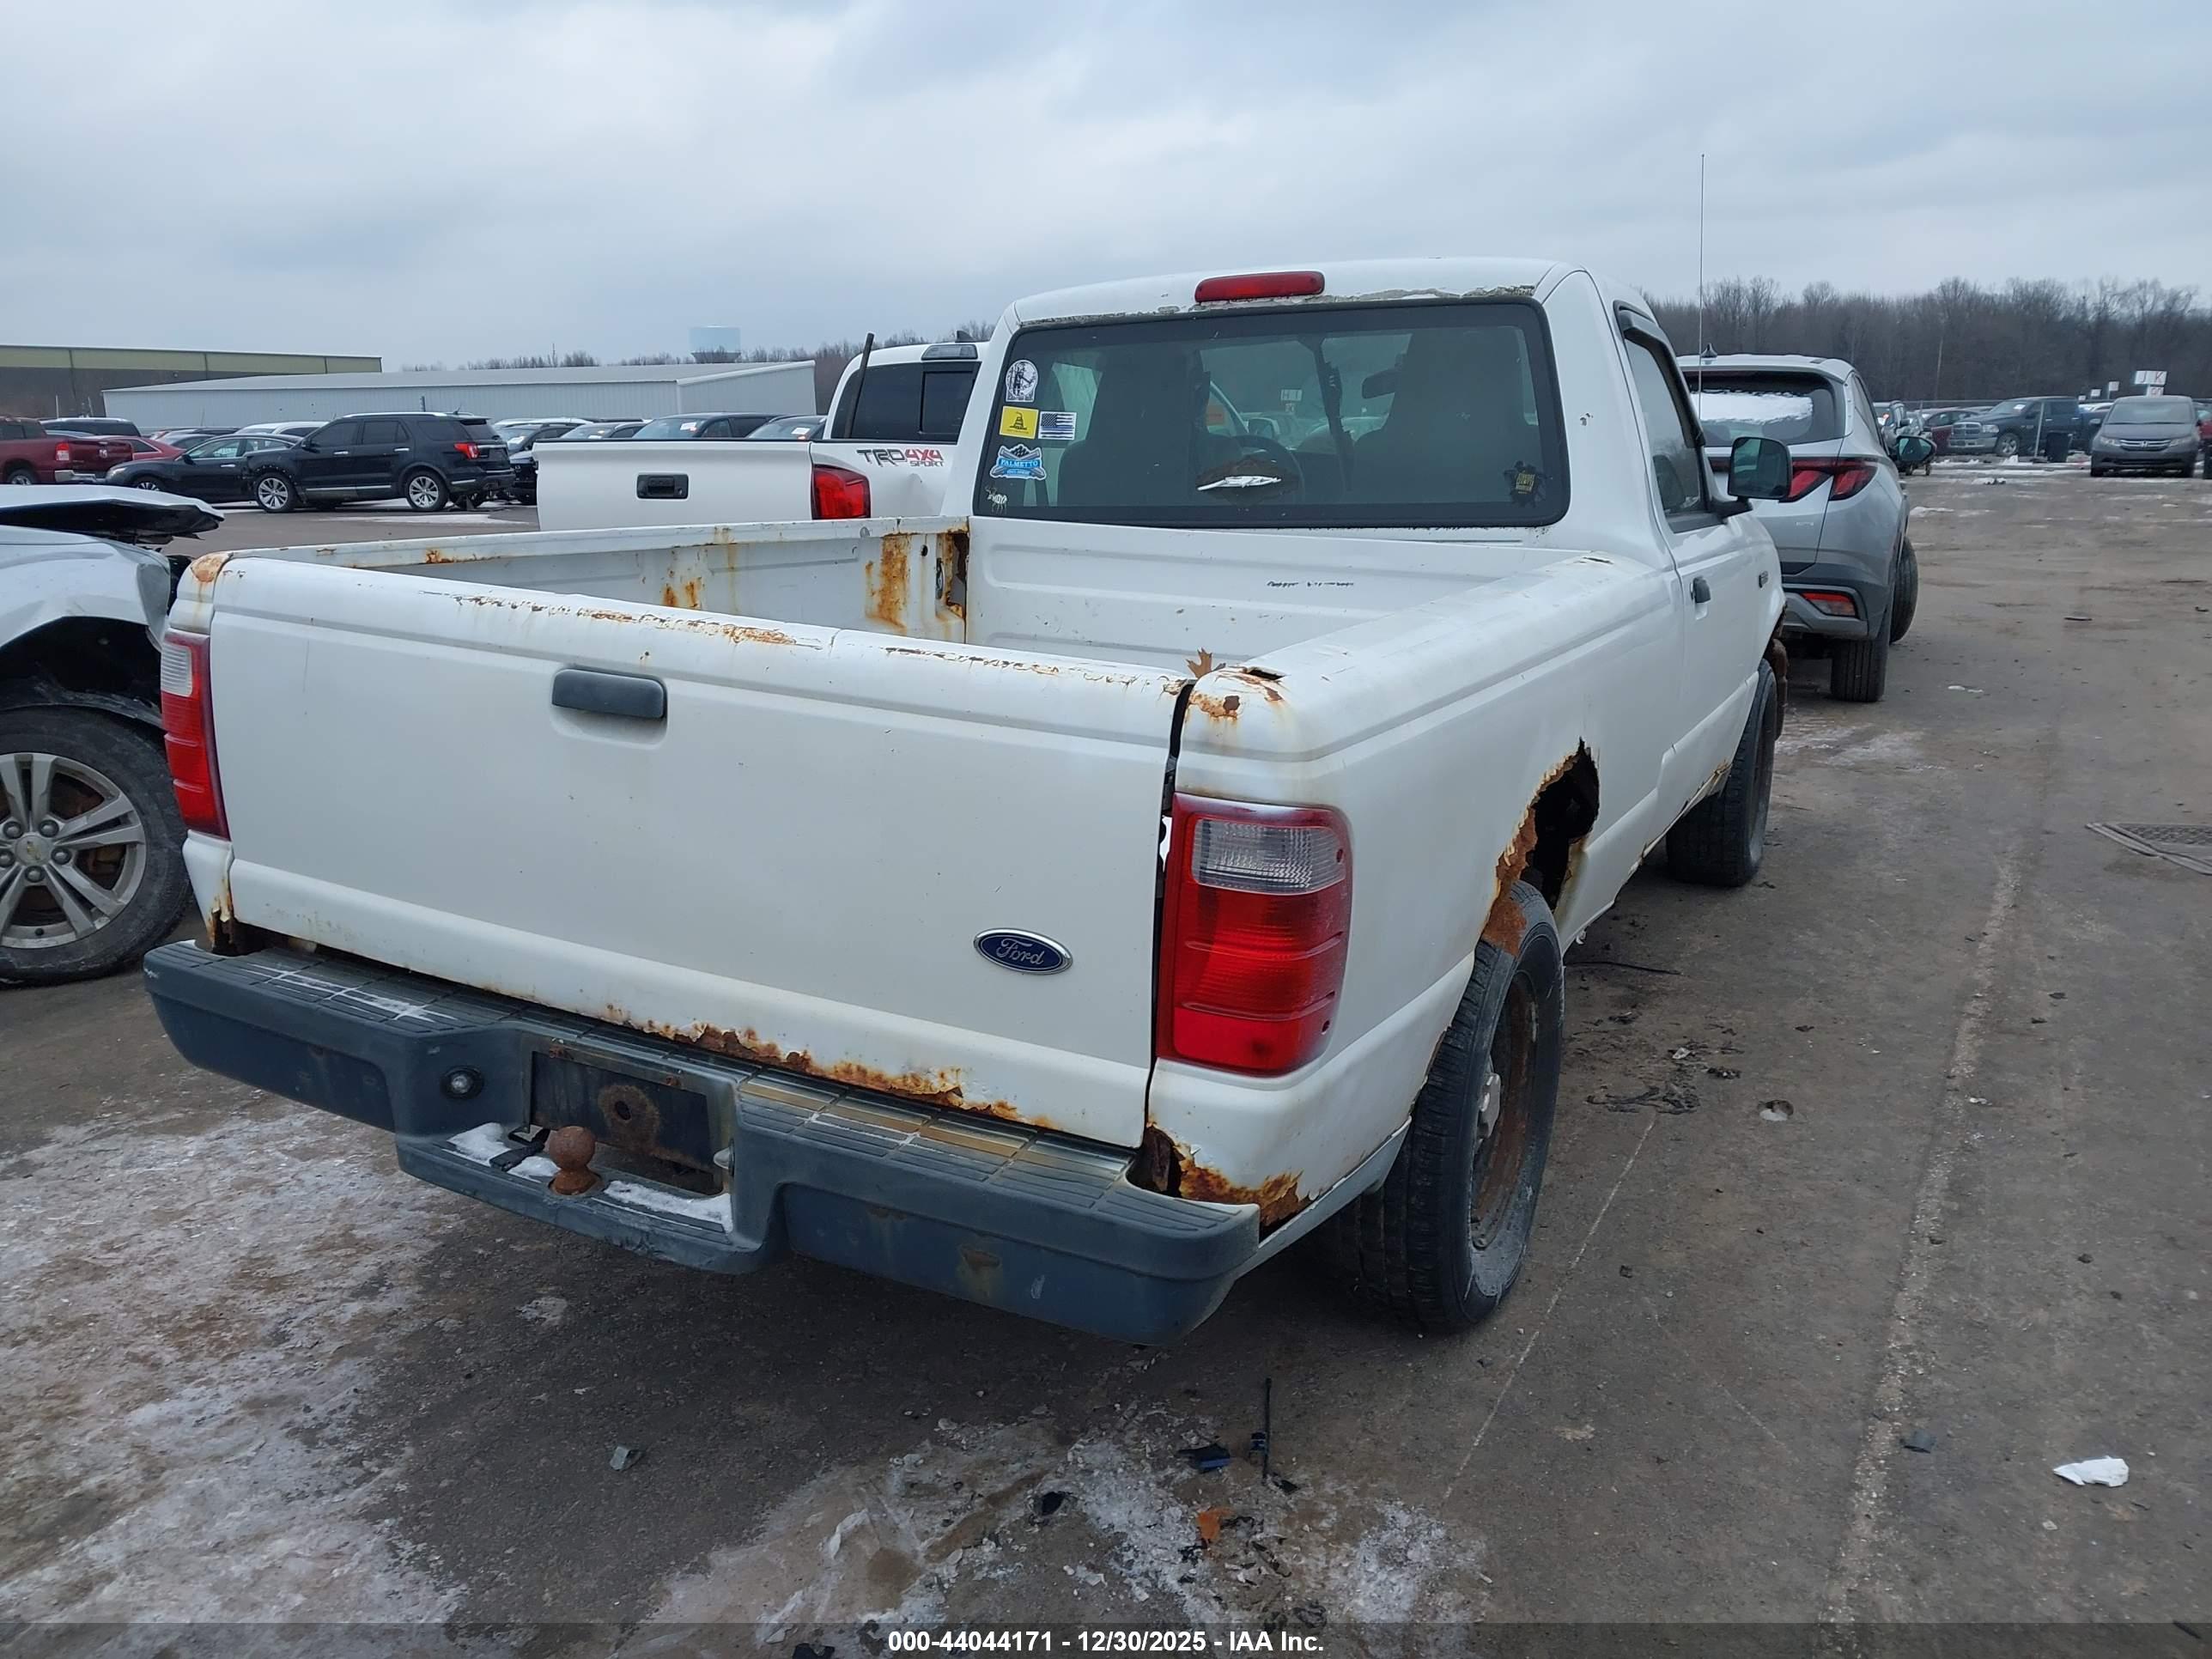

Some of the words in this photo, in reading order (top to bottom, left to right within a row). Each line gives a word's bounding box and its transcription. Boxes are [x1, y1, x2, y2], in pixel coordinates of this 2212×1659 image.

[2154, 372, 2165, 384] K
[856, 448, 908, 467] TRD
[1000, 459, 1039, 469] PALMETTO
[996, 938, 1045, 965] Ford
